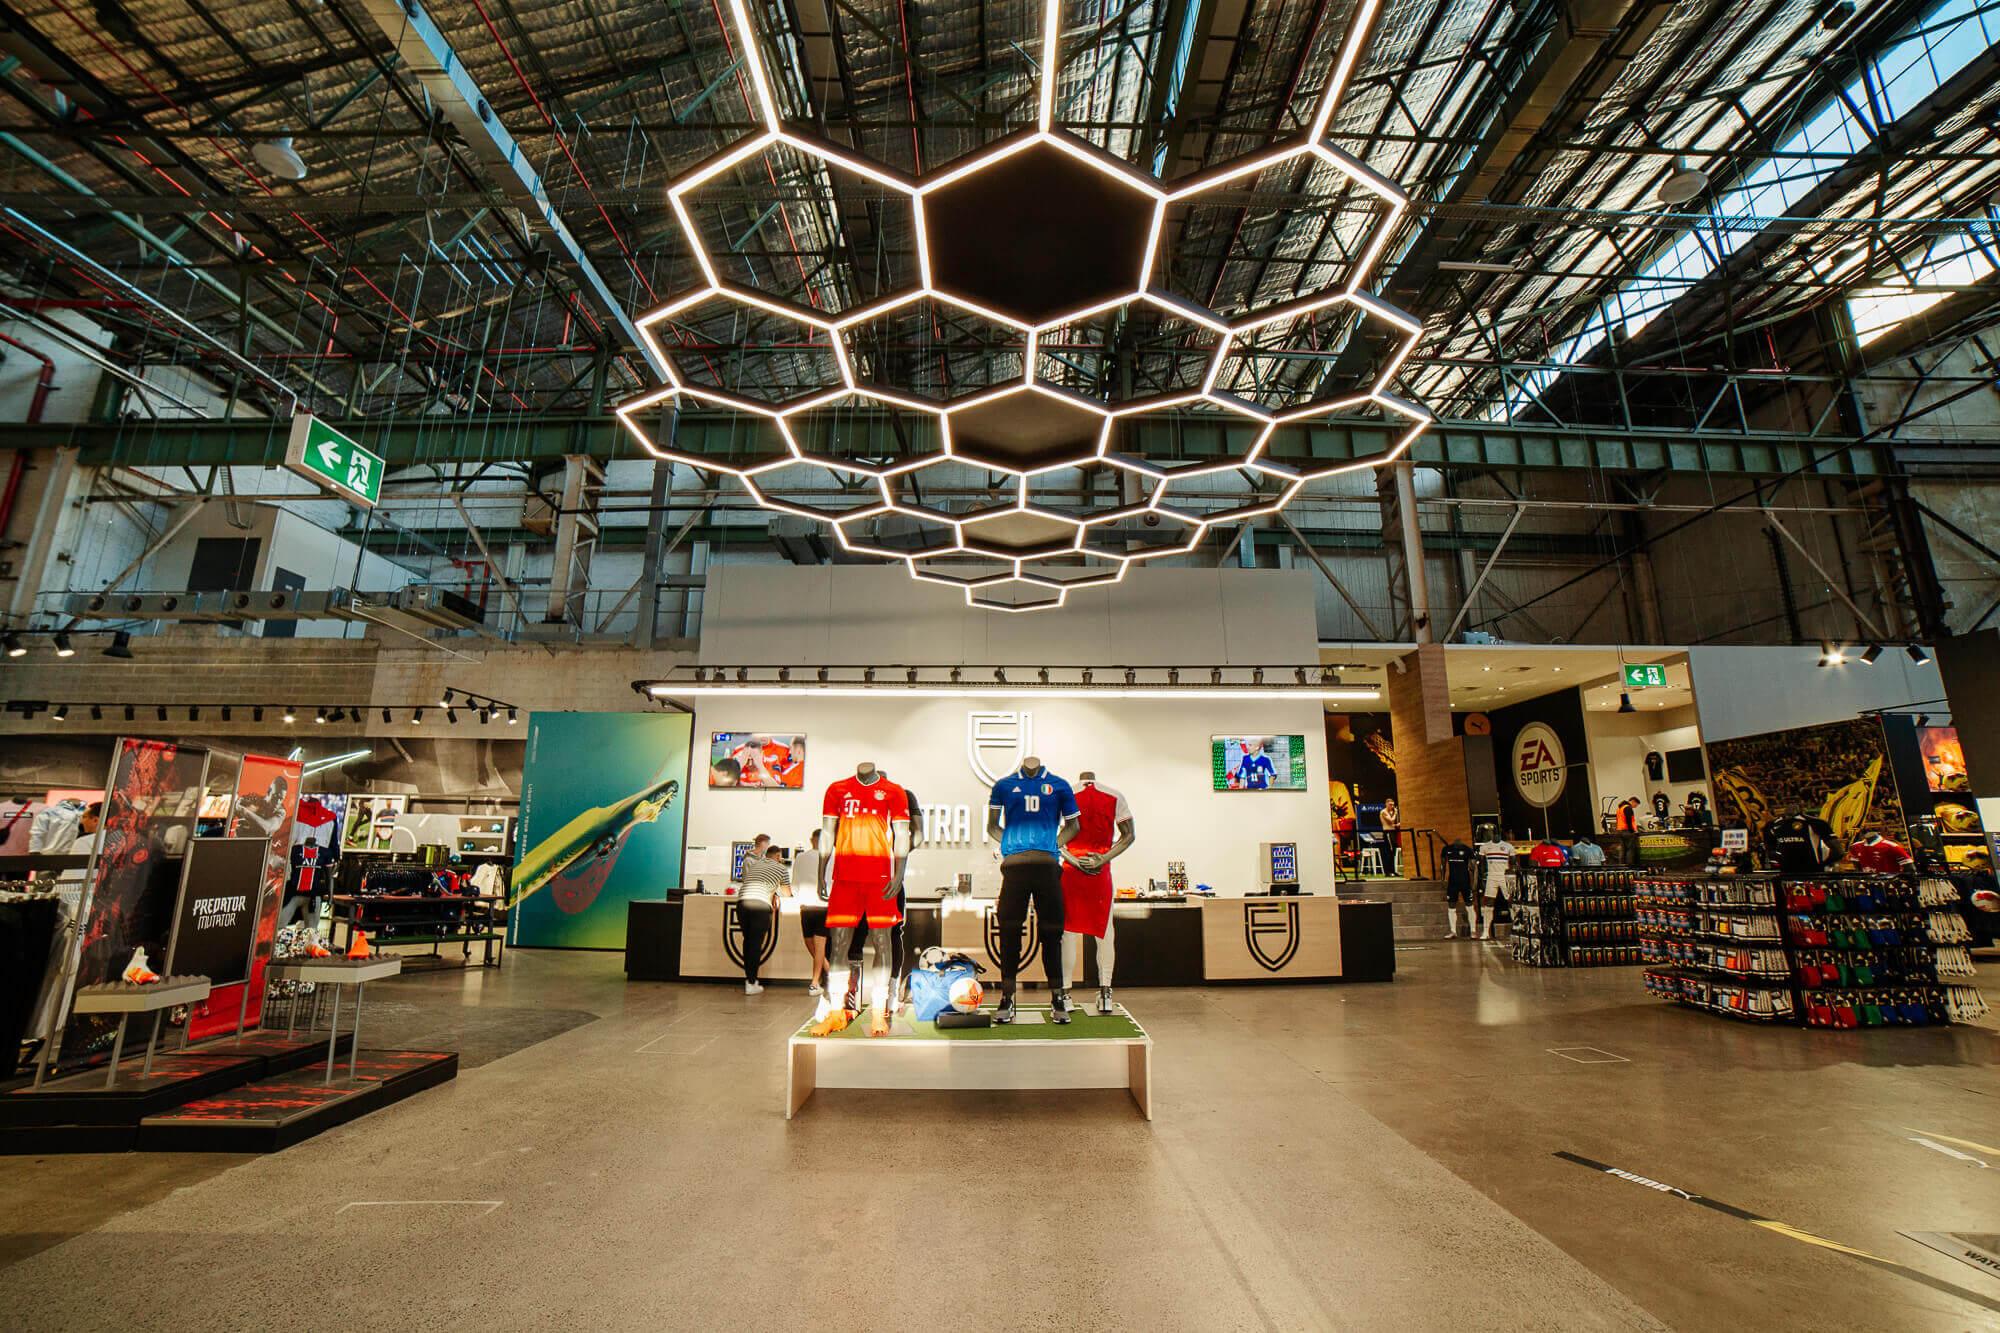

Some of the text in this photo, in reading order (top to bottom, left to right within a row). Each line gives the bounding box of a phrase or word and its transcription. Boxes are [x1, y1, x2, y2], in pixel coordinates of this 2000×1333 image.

[1520, 738, 1556, 771] EA
[1520, 767, 1560, 786] SPORTS
[1024, 794, 1040, 813] 10
[192, 895, 247, 917] PREDATOR
[197, 912, 236, 931] MUTATOR
